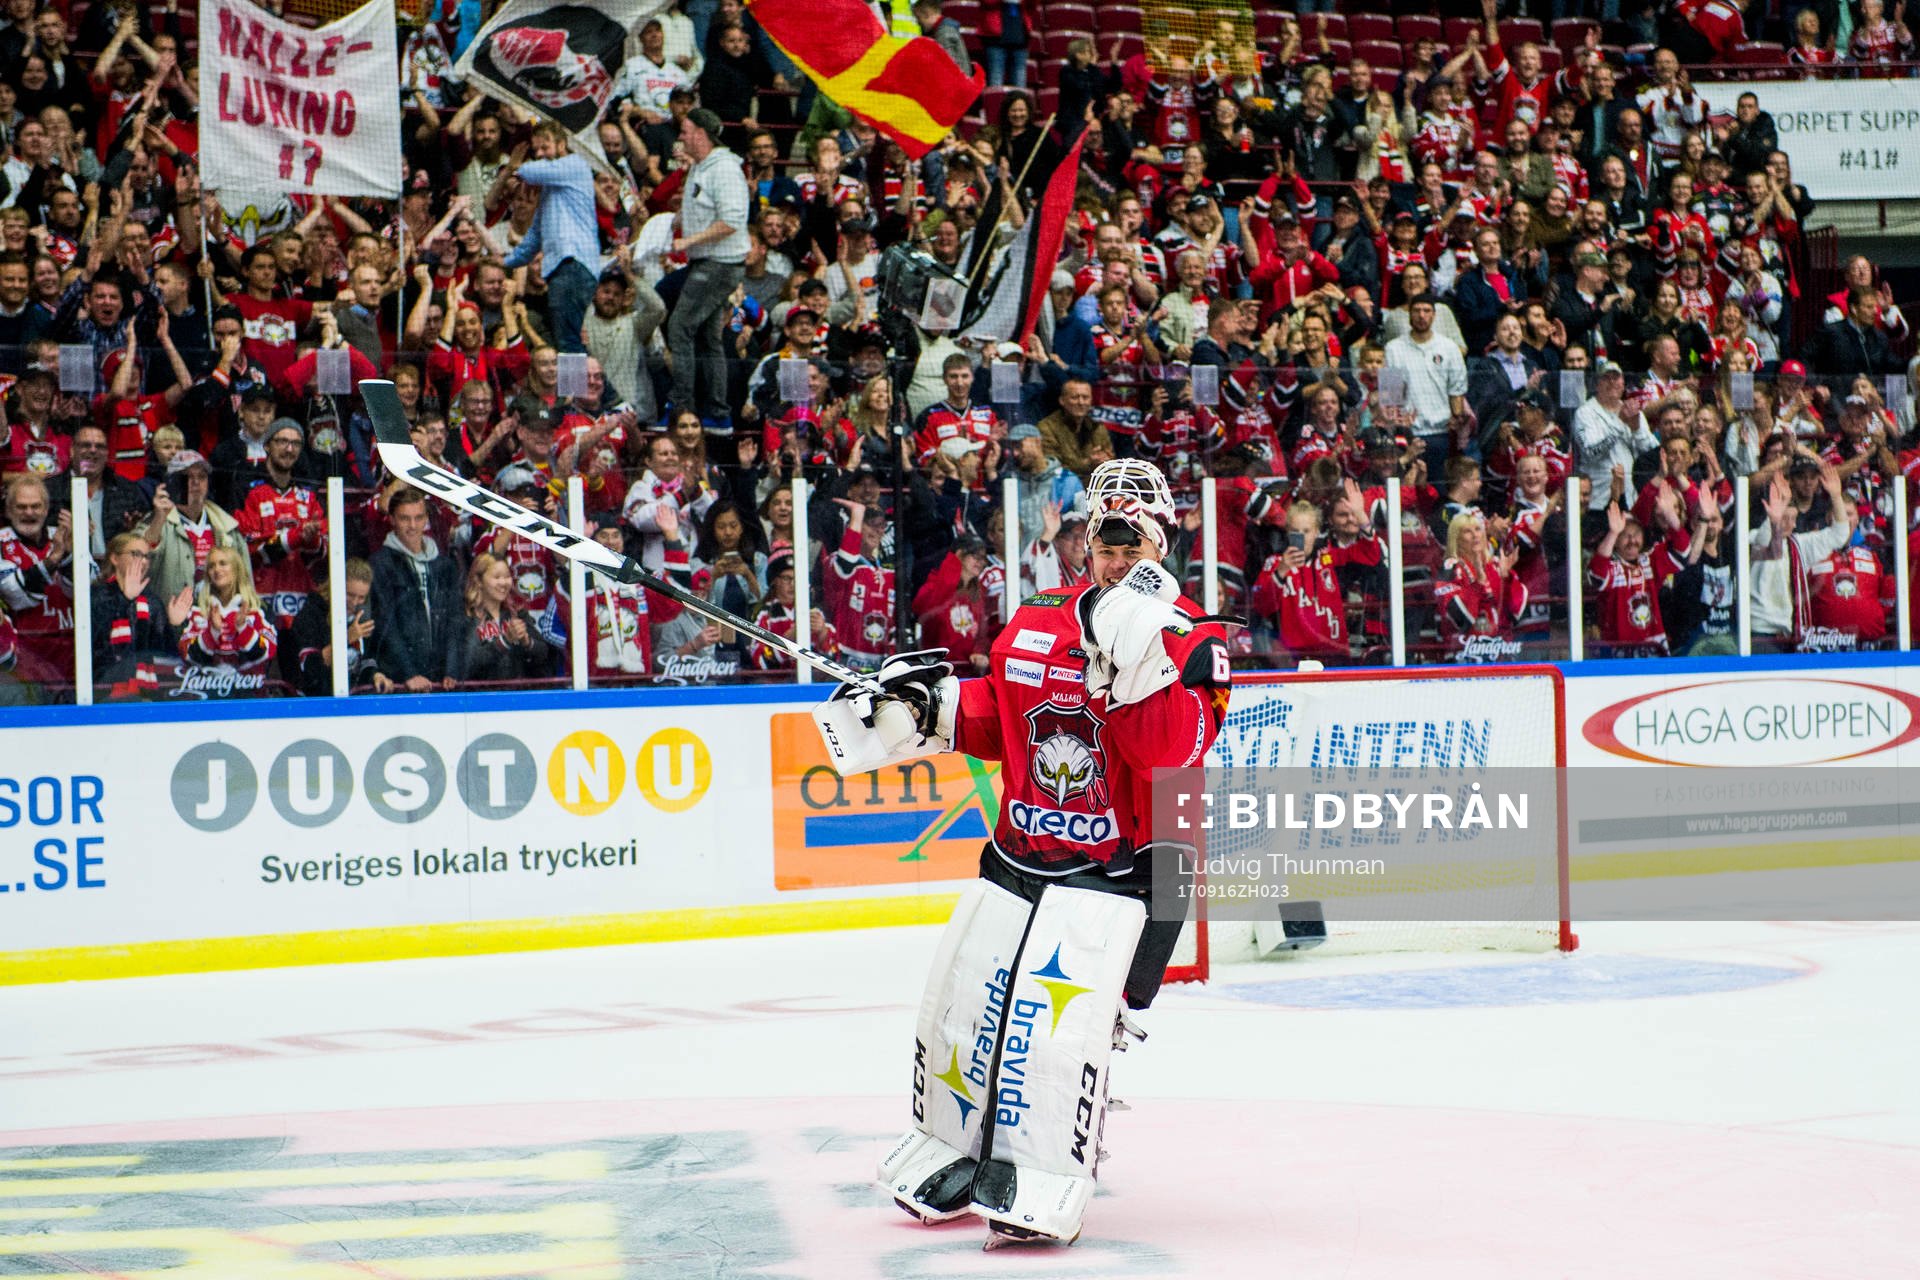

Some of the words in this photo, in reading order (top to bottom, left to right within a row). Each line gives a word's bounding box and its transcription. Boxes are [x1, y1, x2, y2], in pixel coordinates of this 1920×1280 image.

[219, 72, 357, 137] LURING
[278, 139, 323, 186] #7
[1838, 149, 1899, 171] #41#
[407, 461, 585, 549] CCM
[169, 665, 264, 698] Landgren
[653, 655, 736, 686] Landgren
[823, 721, 844, 758] CCM
[1636, 707, 1737, 747] HAGA
[1743, 701, 1891, 742] GRUPPEN
[1655, 777, 1876, 803] FASTIGHETSFÖRVALTNING
[1011, 802, 1111, 843] areco
[1686, 809, 1848, 833] www.hagagruppen.com
[260, 852, 403, 887] Sveriges
[412, 846, 509, 877] lokala
[519, 838, 638, 877] tryckeri
[962, 967, 1010, 1089] bravida
[912, 1036, 927, 1124] CCM
[994, 998, 1048, 1128] bravida
[1069, 1061, 1099, 1166] CCM
